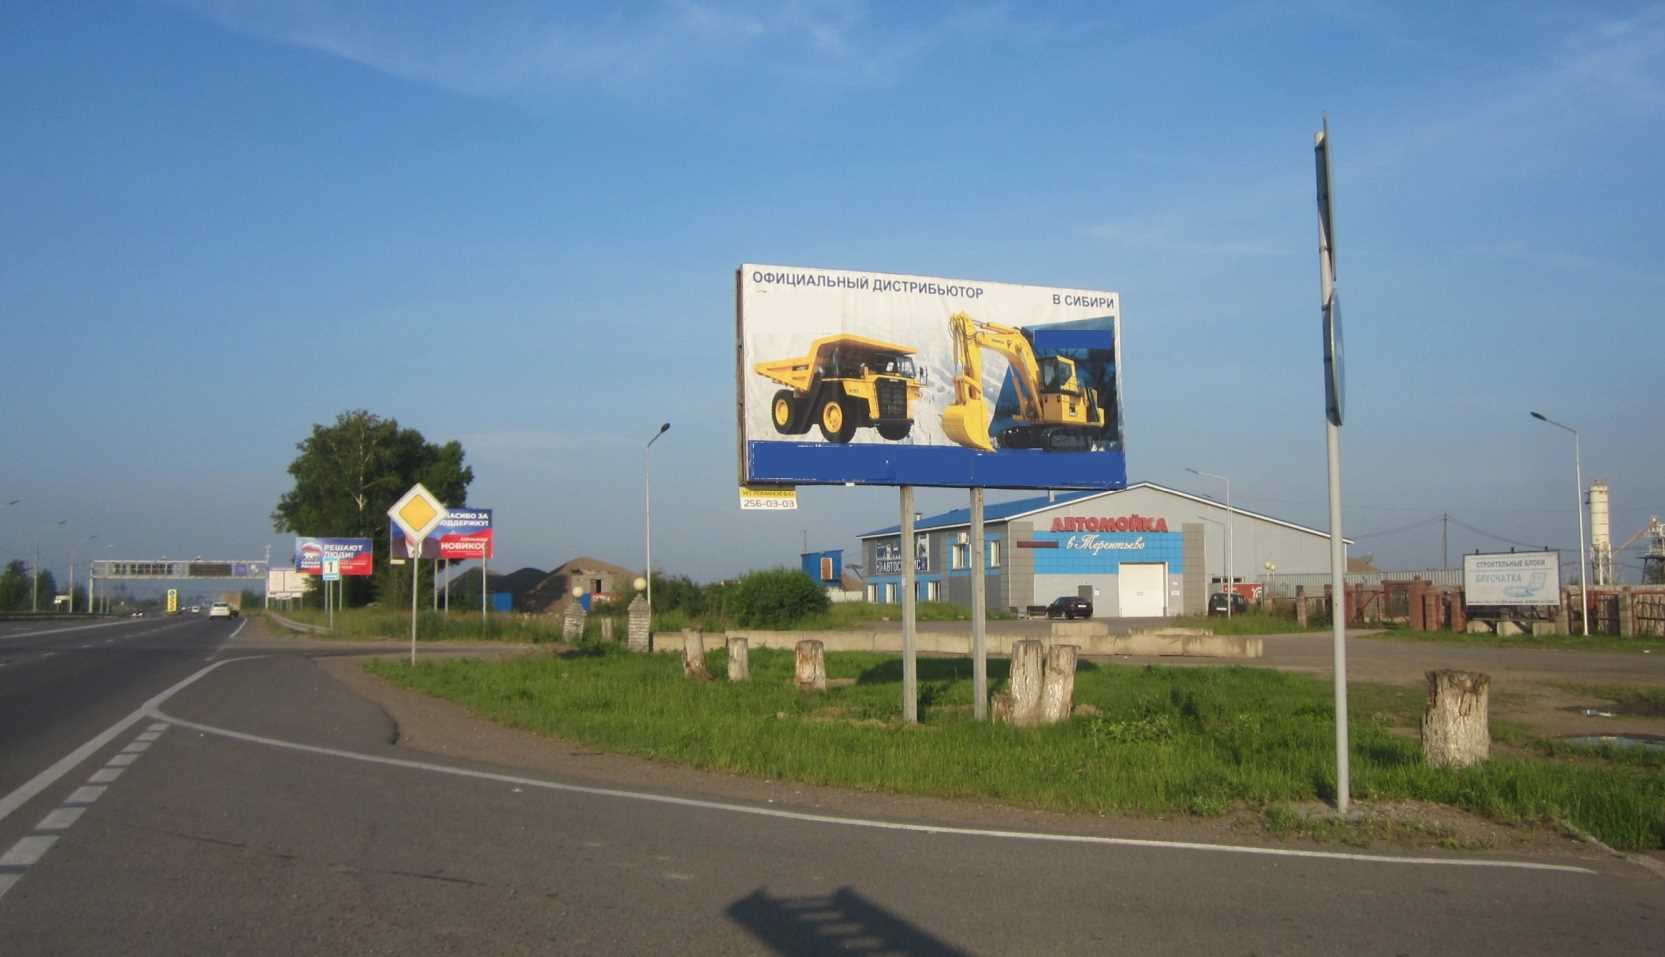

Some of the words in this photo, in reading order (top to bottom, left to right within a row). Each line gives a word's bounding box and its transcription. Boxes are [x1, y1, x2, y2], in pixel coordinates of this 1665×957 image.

[752, 270, 869, 290] ОФИЦИАЛЬНЫЙ
[873, 279, 984, 299] ДИСТРИБЬЮТОР
[1053, 294, 1061, 305] В
[1065, 294, 1115, 309] СИБИРИ
[743, 499, 795, 508] 256-03-03
[447, 512, 476, 520] АСИБО
[1051, 513, 1169, 533] АВТОМОЙКА
[324, 544, 363, 552] РЕШАЮТ
